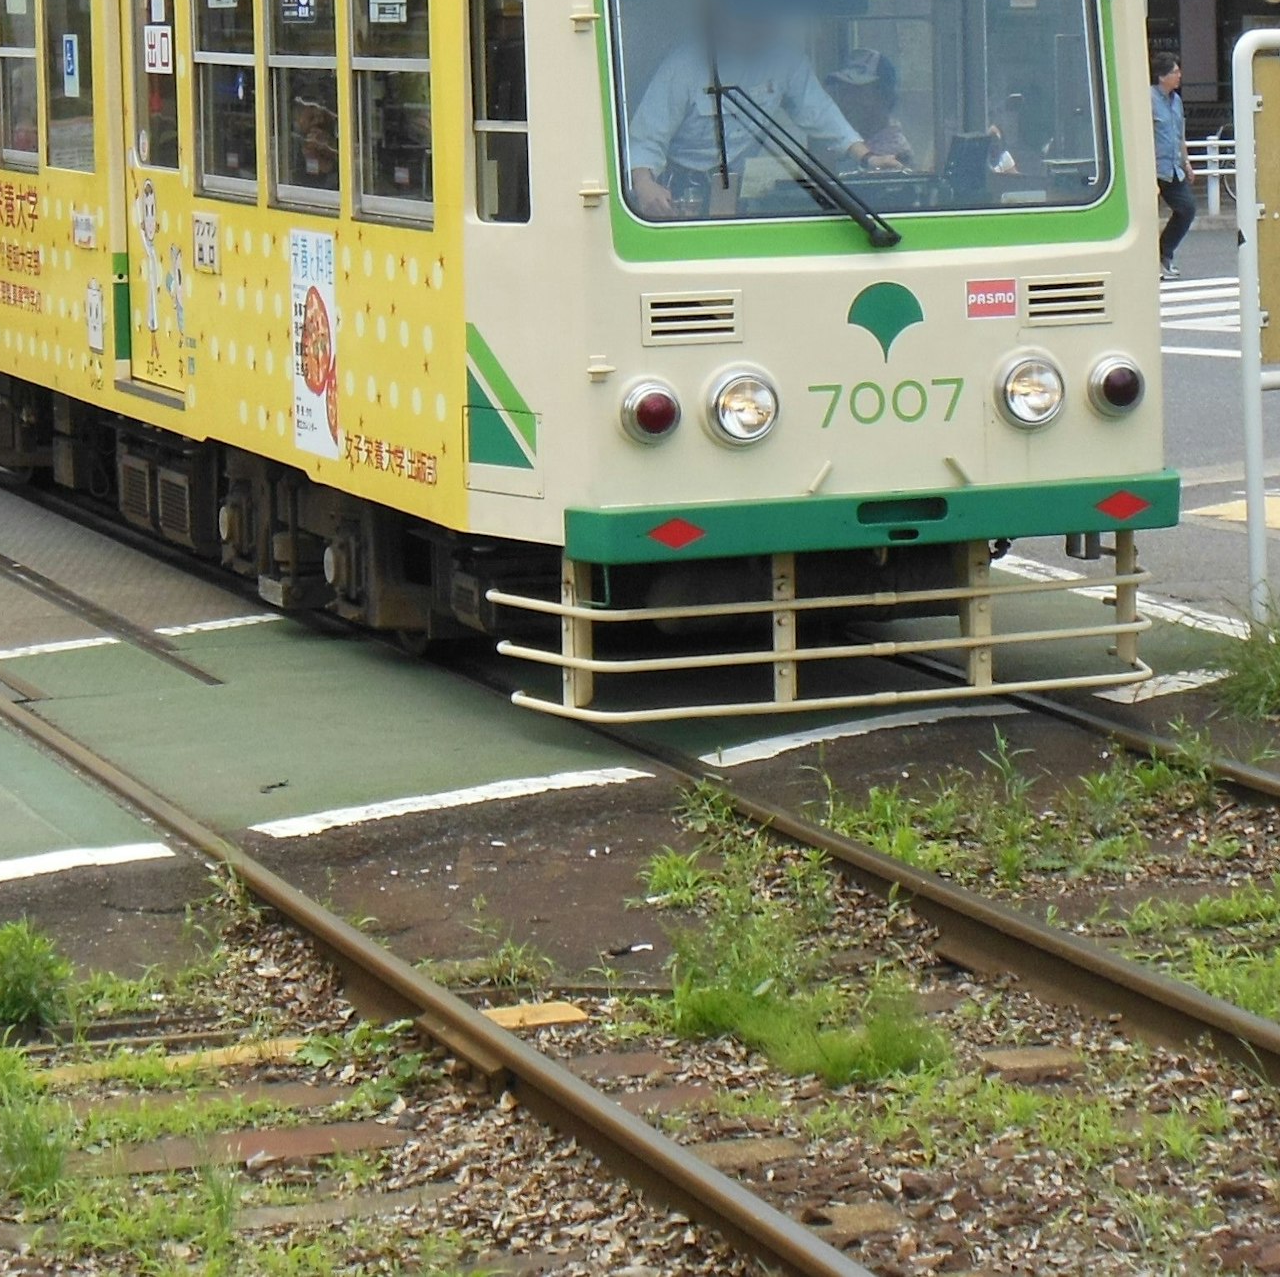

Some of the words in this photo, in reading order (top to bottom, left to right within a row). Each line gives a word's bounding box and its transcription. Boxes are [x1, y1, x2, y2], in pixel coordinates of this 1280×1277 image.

[146, 31, 169, 68] 出口
[967, 290, 1016, 308] PASMO
[807, 376, 965, 430] 7007
[345, 429, 438, 485] 女子栄養大学出版部
